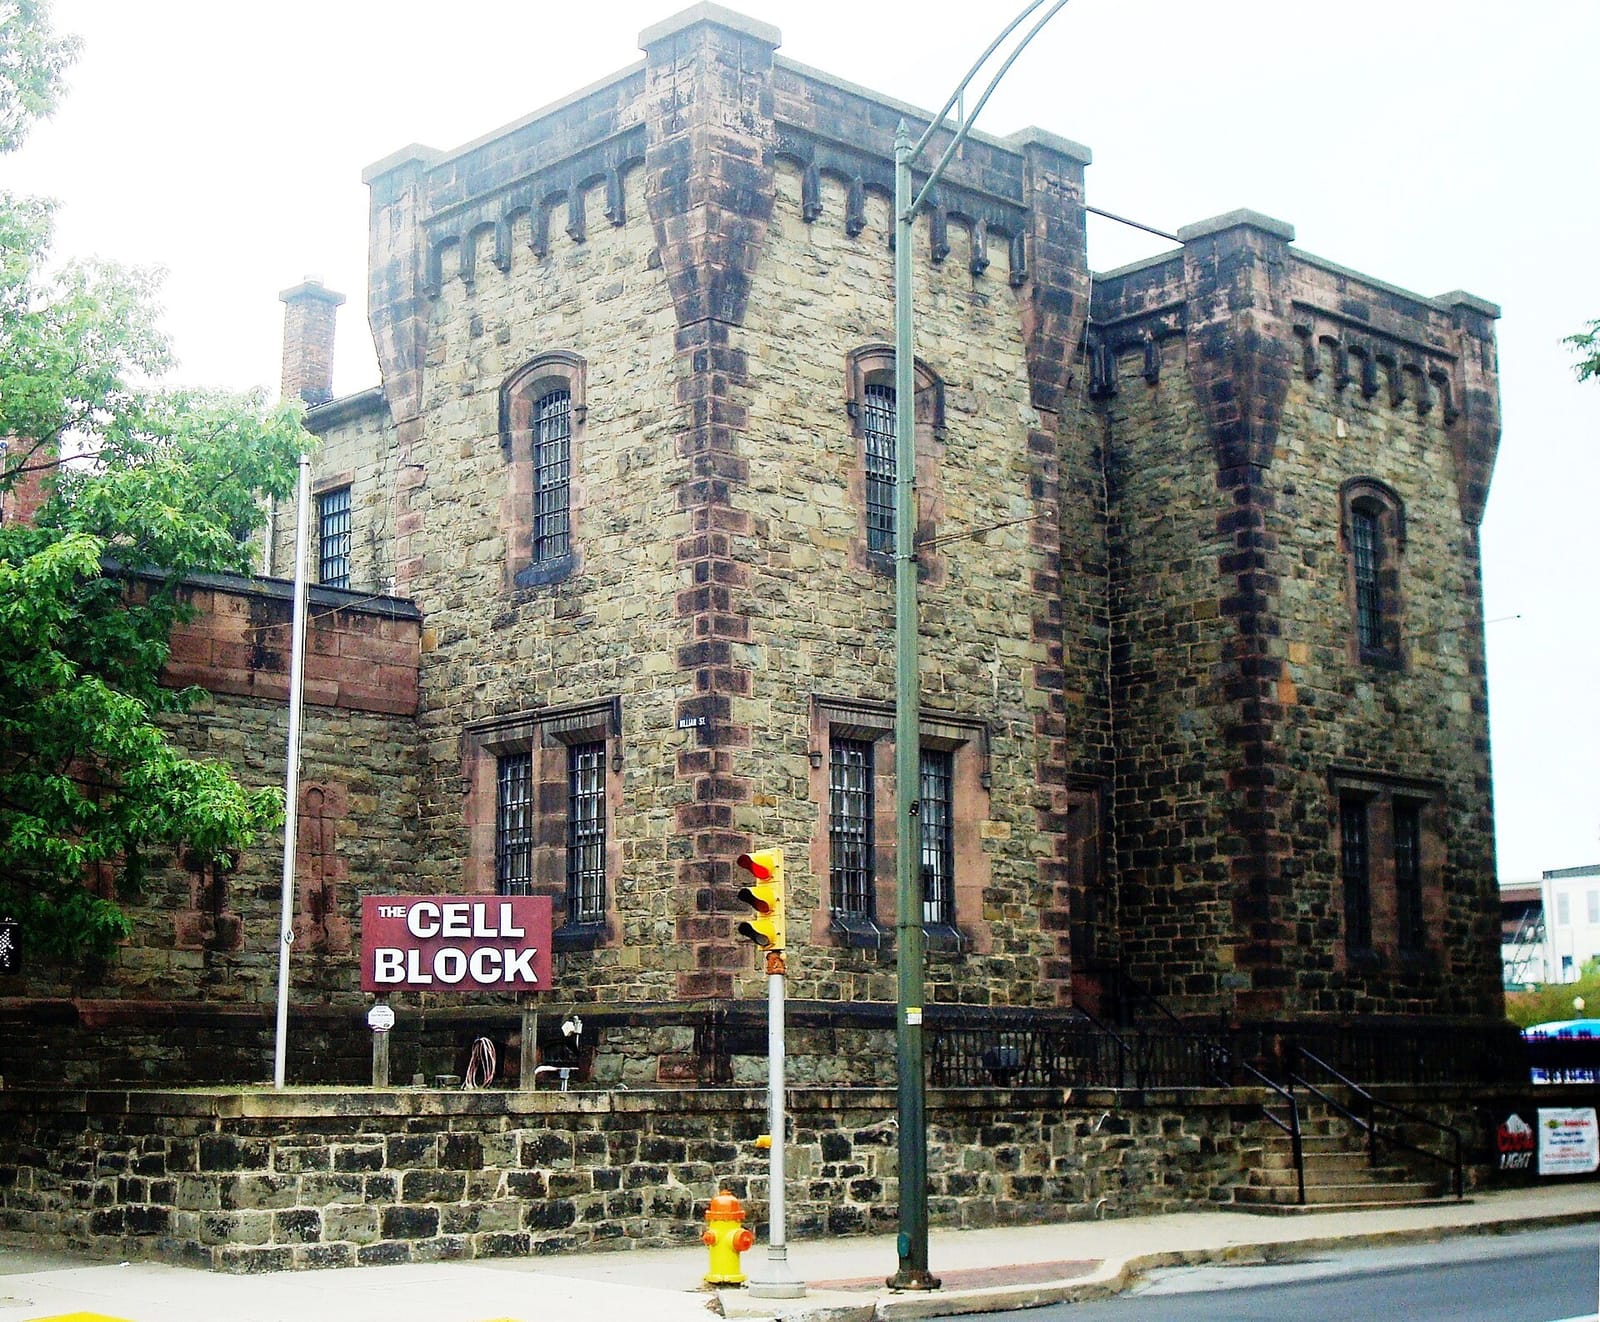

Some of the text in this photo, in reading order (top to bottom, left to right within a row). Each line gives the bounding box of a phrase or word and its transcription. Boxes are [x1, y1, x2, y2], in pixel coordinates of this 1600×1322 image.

[378, 901, 525, 938] THE CELL
[374, 947, 538, 984] BLOCK
[1500, 1152, 1533, 1169] LIGHT
